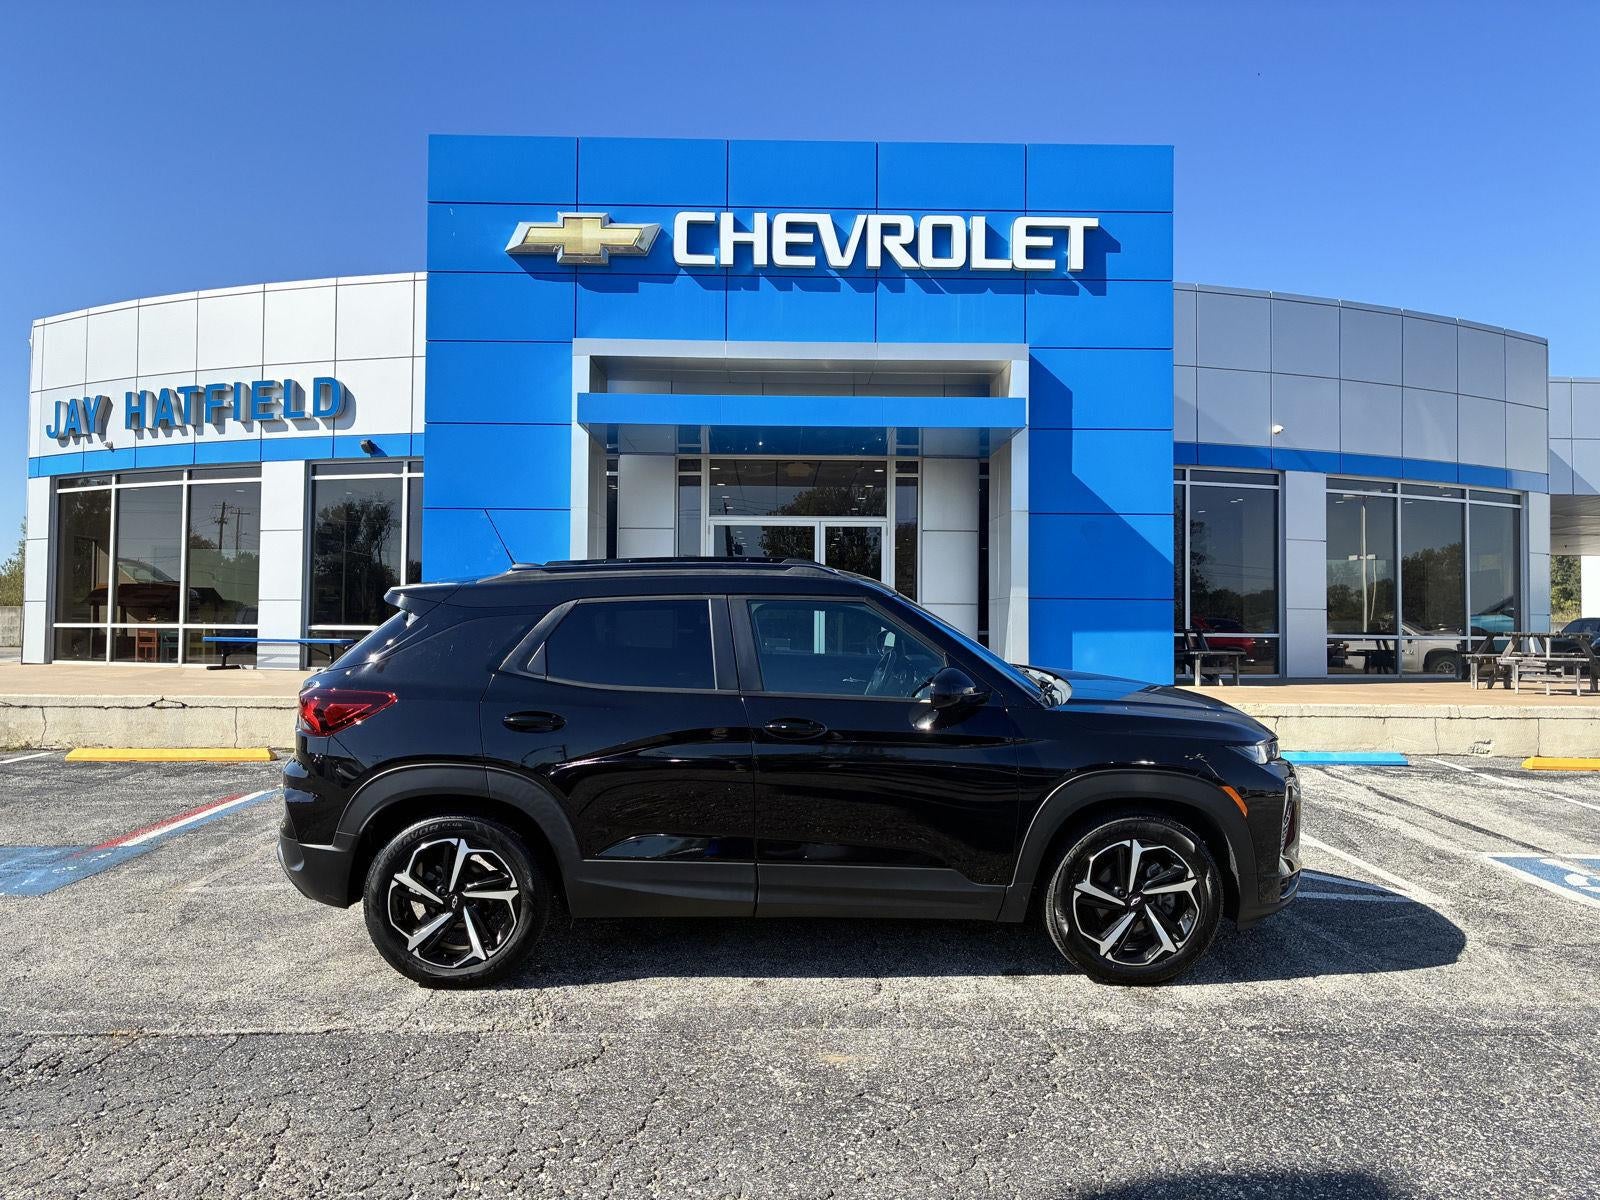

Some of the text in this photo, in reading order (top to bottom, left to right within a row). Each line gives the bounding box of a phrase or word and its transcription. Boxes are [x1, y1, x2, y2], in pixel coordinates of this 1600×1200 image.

[673, 211, 1099, 272] CHEVROLET
[46, 377, 348, 439] JAY HATFIELD
